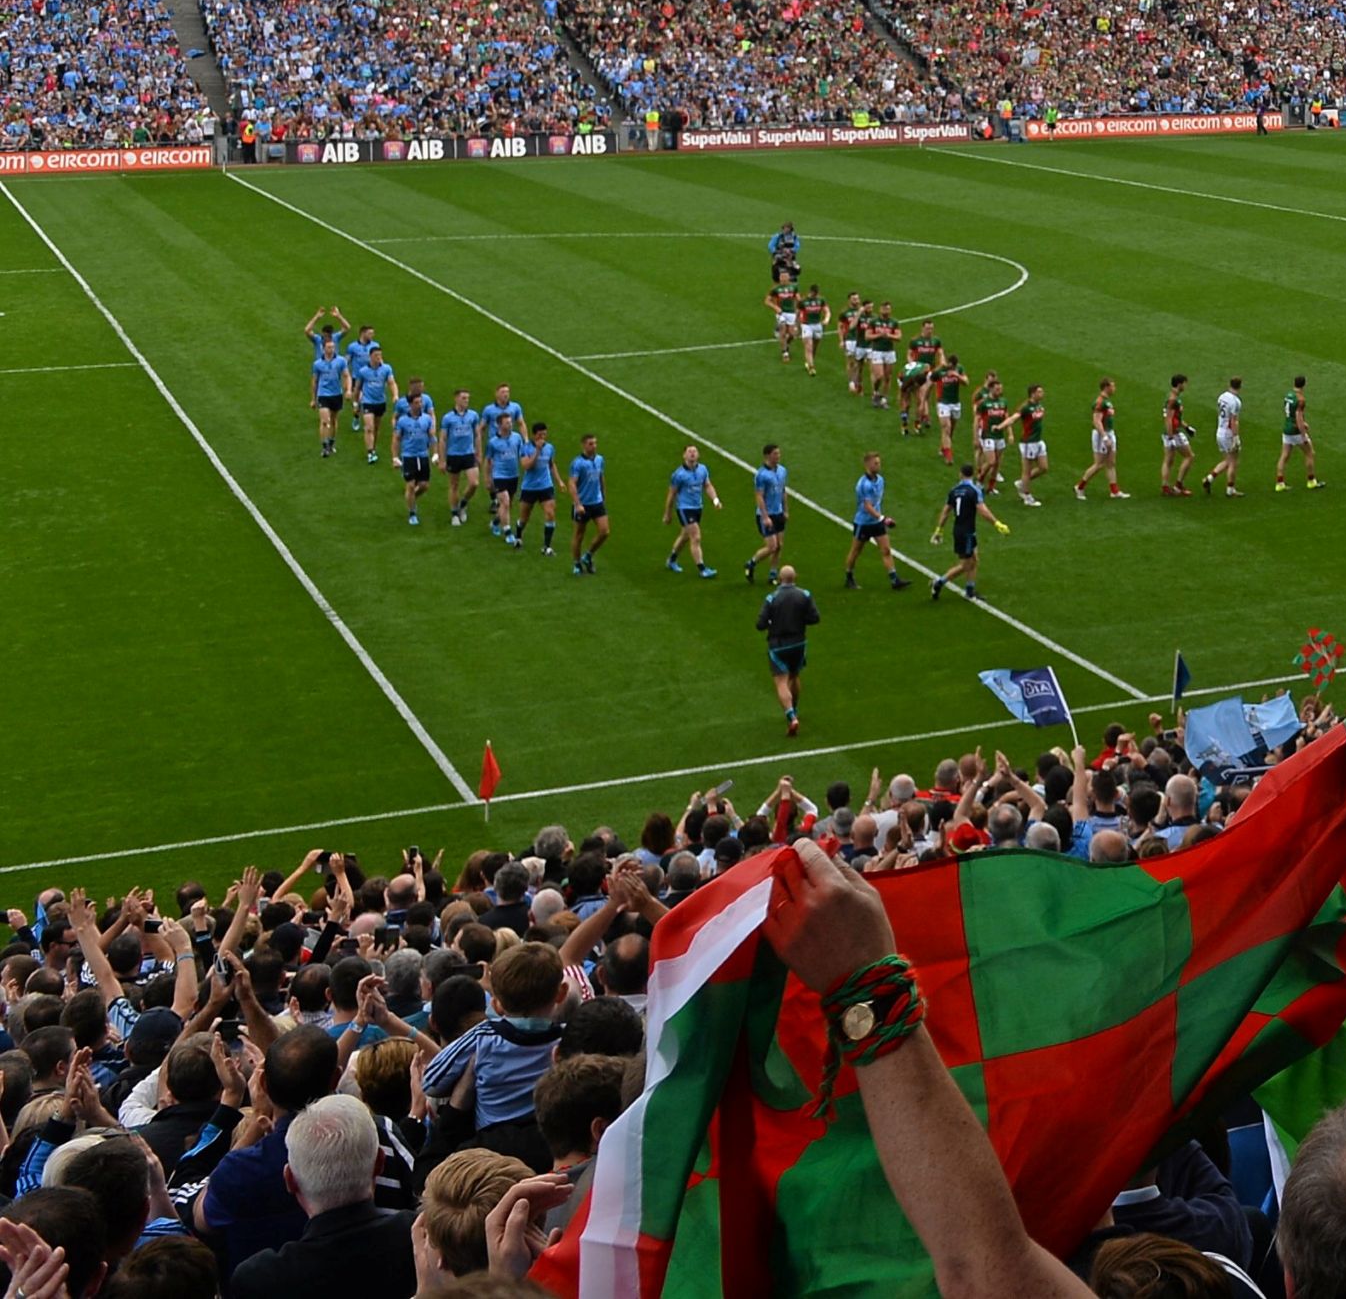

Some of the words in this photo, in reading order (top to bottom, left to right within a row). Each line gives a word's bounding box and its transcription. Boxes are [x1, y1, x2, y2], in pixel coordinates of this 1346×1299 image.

[903, 124, 968, 141] SuperValu
[1107, 119, 1157, 134] eircom
[1171, 116, 1220, 131] eircom
[682, 130, 752, 149] SuperValu
[758, 129, 825, 146] SuperValu
[832, 127, 898, 144] SuperValu
[322, 142, 360, 163] AIB
[407, 140, 445, 161] AIB
[490, 138, 527, 158] AIB
[571, 135, 607, 155] AIB
[47, 149, 119, 168] eircom
[140, 148, 210, 166] eircom
